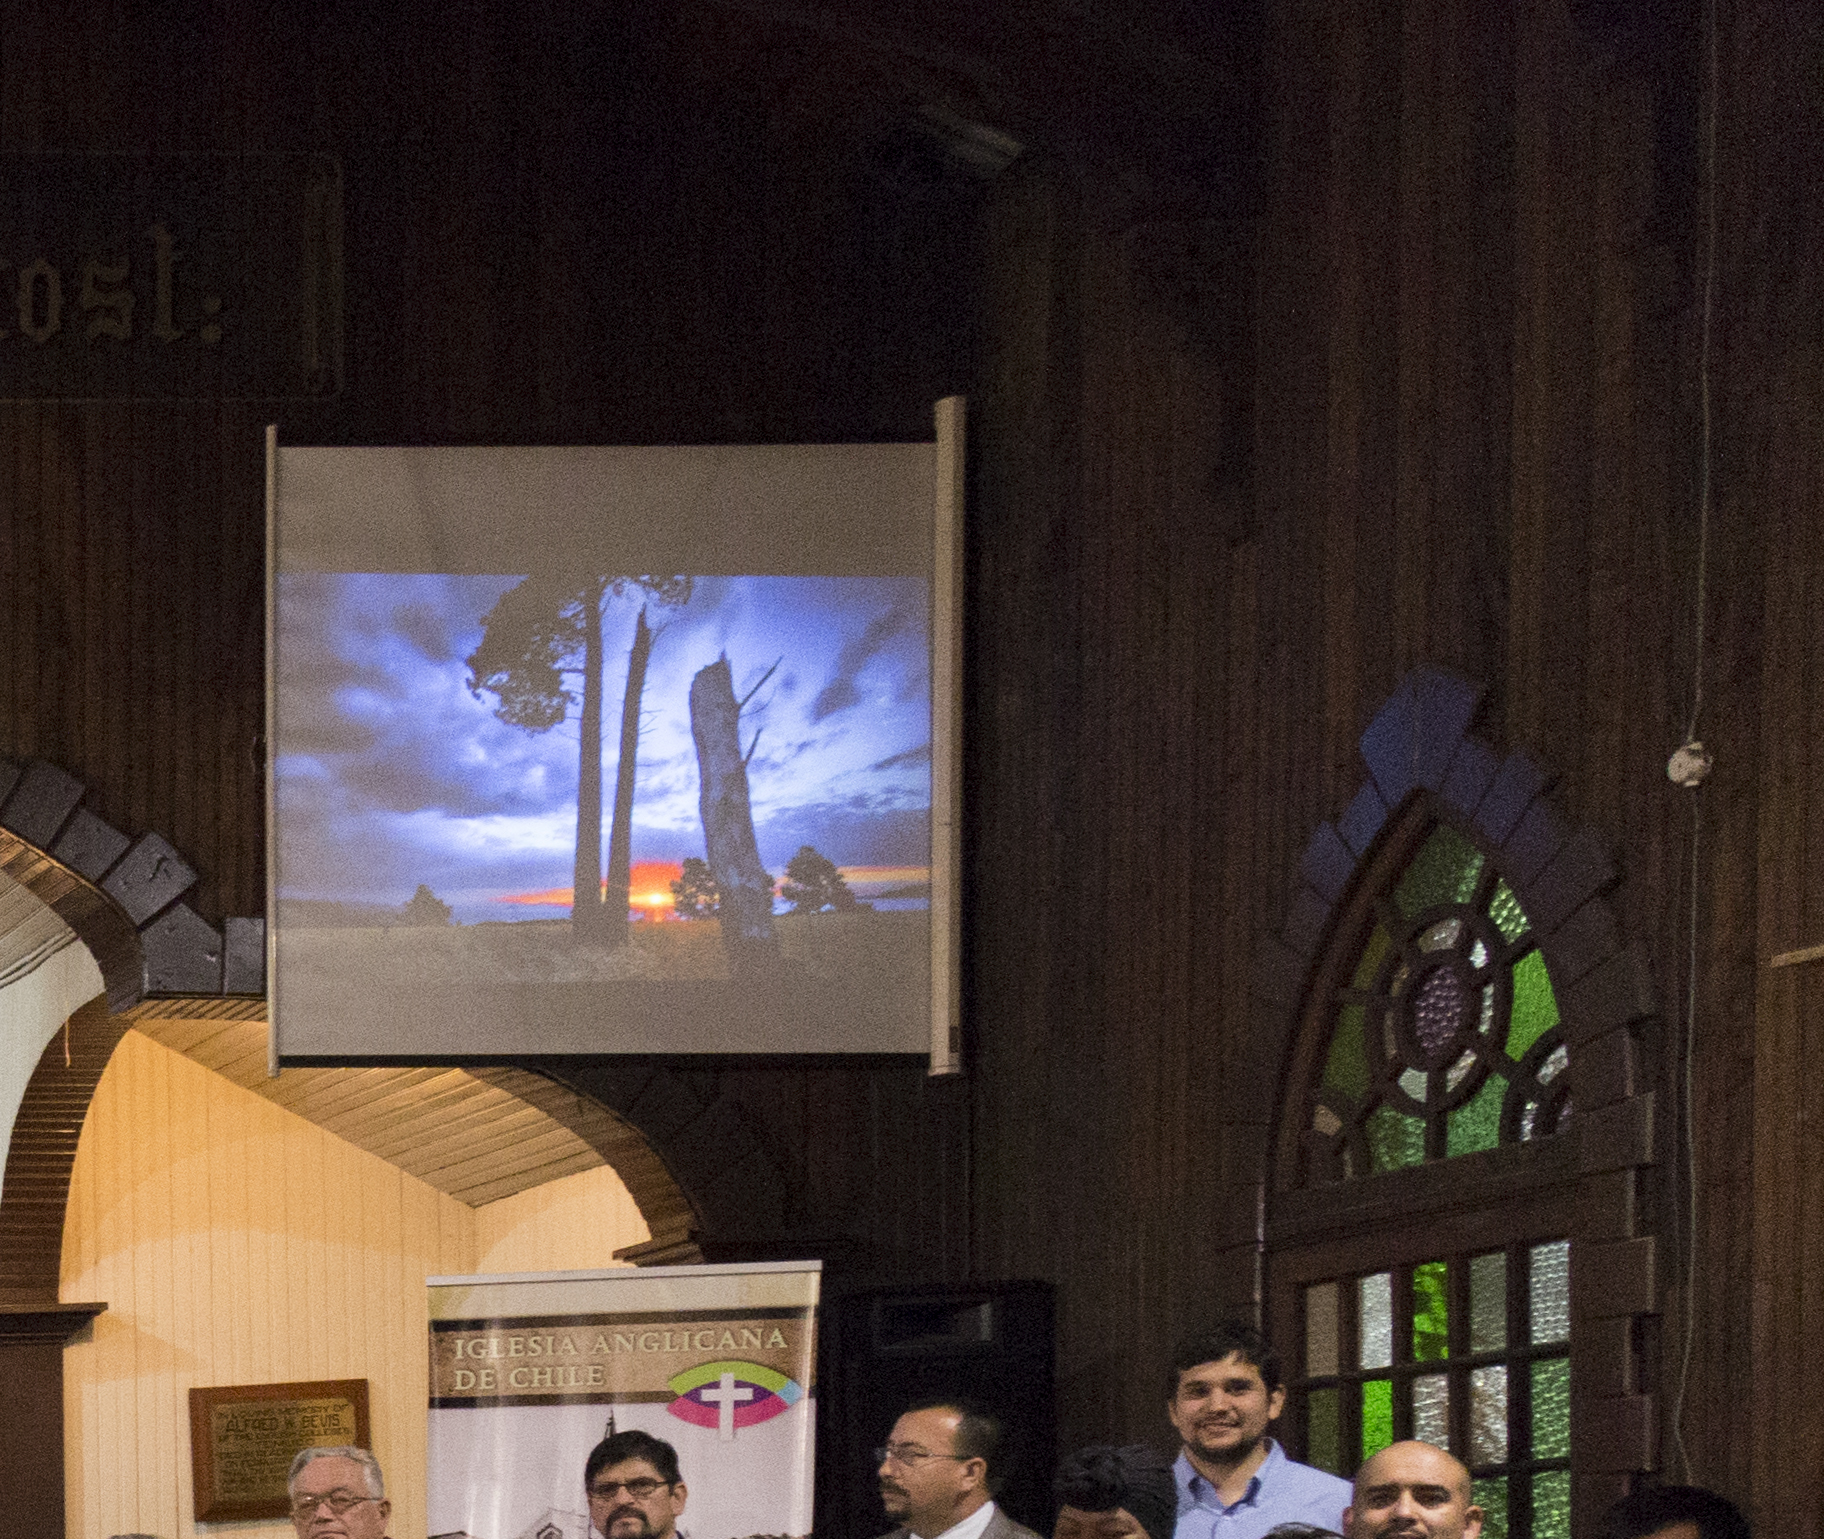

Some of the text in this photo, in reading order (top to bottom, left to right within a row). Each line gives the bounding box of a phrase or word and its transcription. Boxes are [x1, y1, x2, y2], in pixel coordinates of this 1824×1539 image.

[453, 1327, 788, 1360] IGLESIA ANGLICANA
[454, 1366, 605, 1391] DE CHILE
